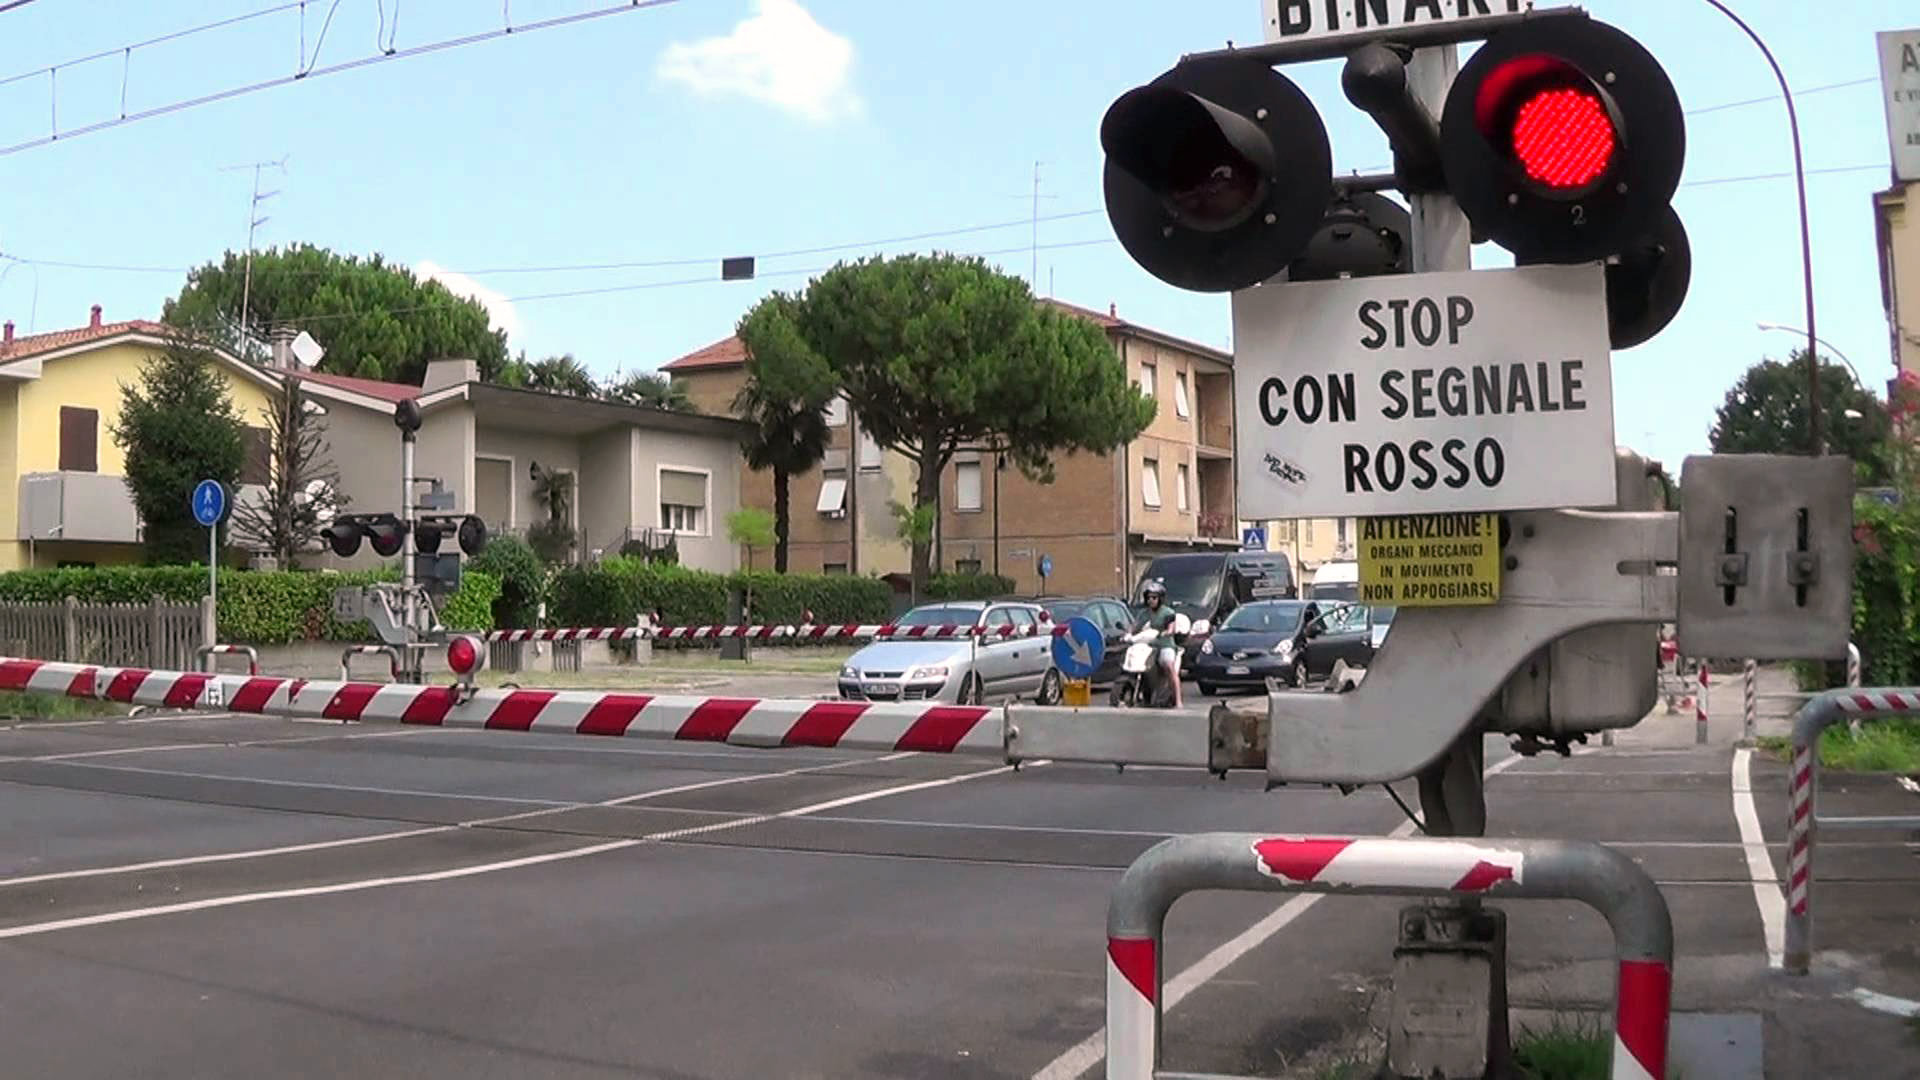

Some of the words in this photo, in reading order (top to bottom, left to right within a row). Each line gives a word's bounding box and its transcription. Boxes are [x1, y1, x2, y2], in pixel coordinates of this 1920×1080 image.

[1902, 42, 1920, 72] A
[1358, 295, 1474, 349] STOP
[1259, 373, 1356, 426] CON
[1380, 360, 1586, 419] SEGNALE
[1343, 437, 1504, 492] ROSSO
[1371, 545, 1413, 559] ORGANI
[1420, 544, 1482, 558] MECCANICI
[1380, 565, 1393, 578] IN
[1401, 563, 1473, 577] MOVIMENTO
[1363, 584, 1393, 600] NON
[1403, 582, 1493, 599] APPOGGIARSI
